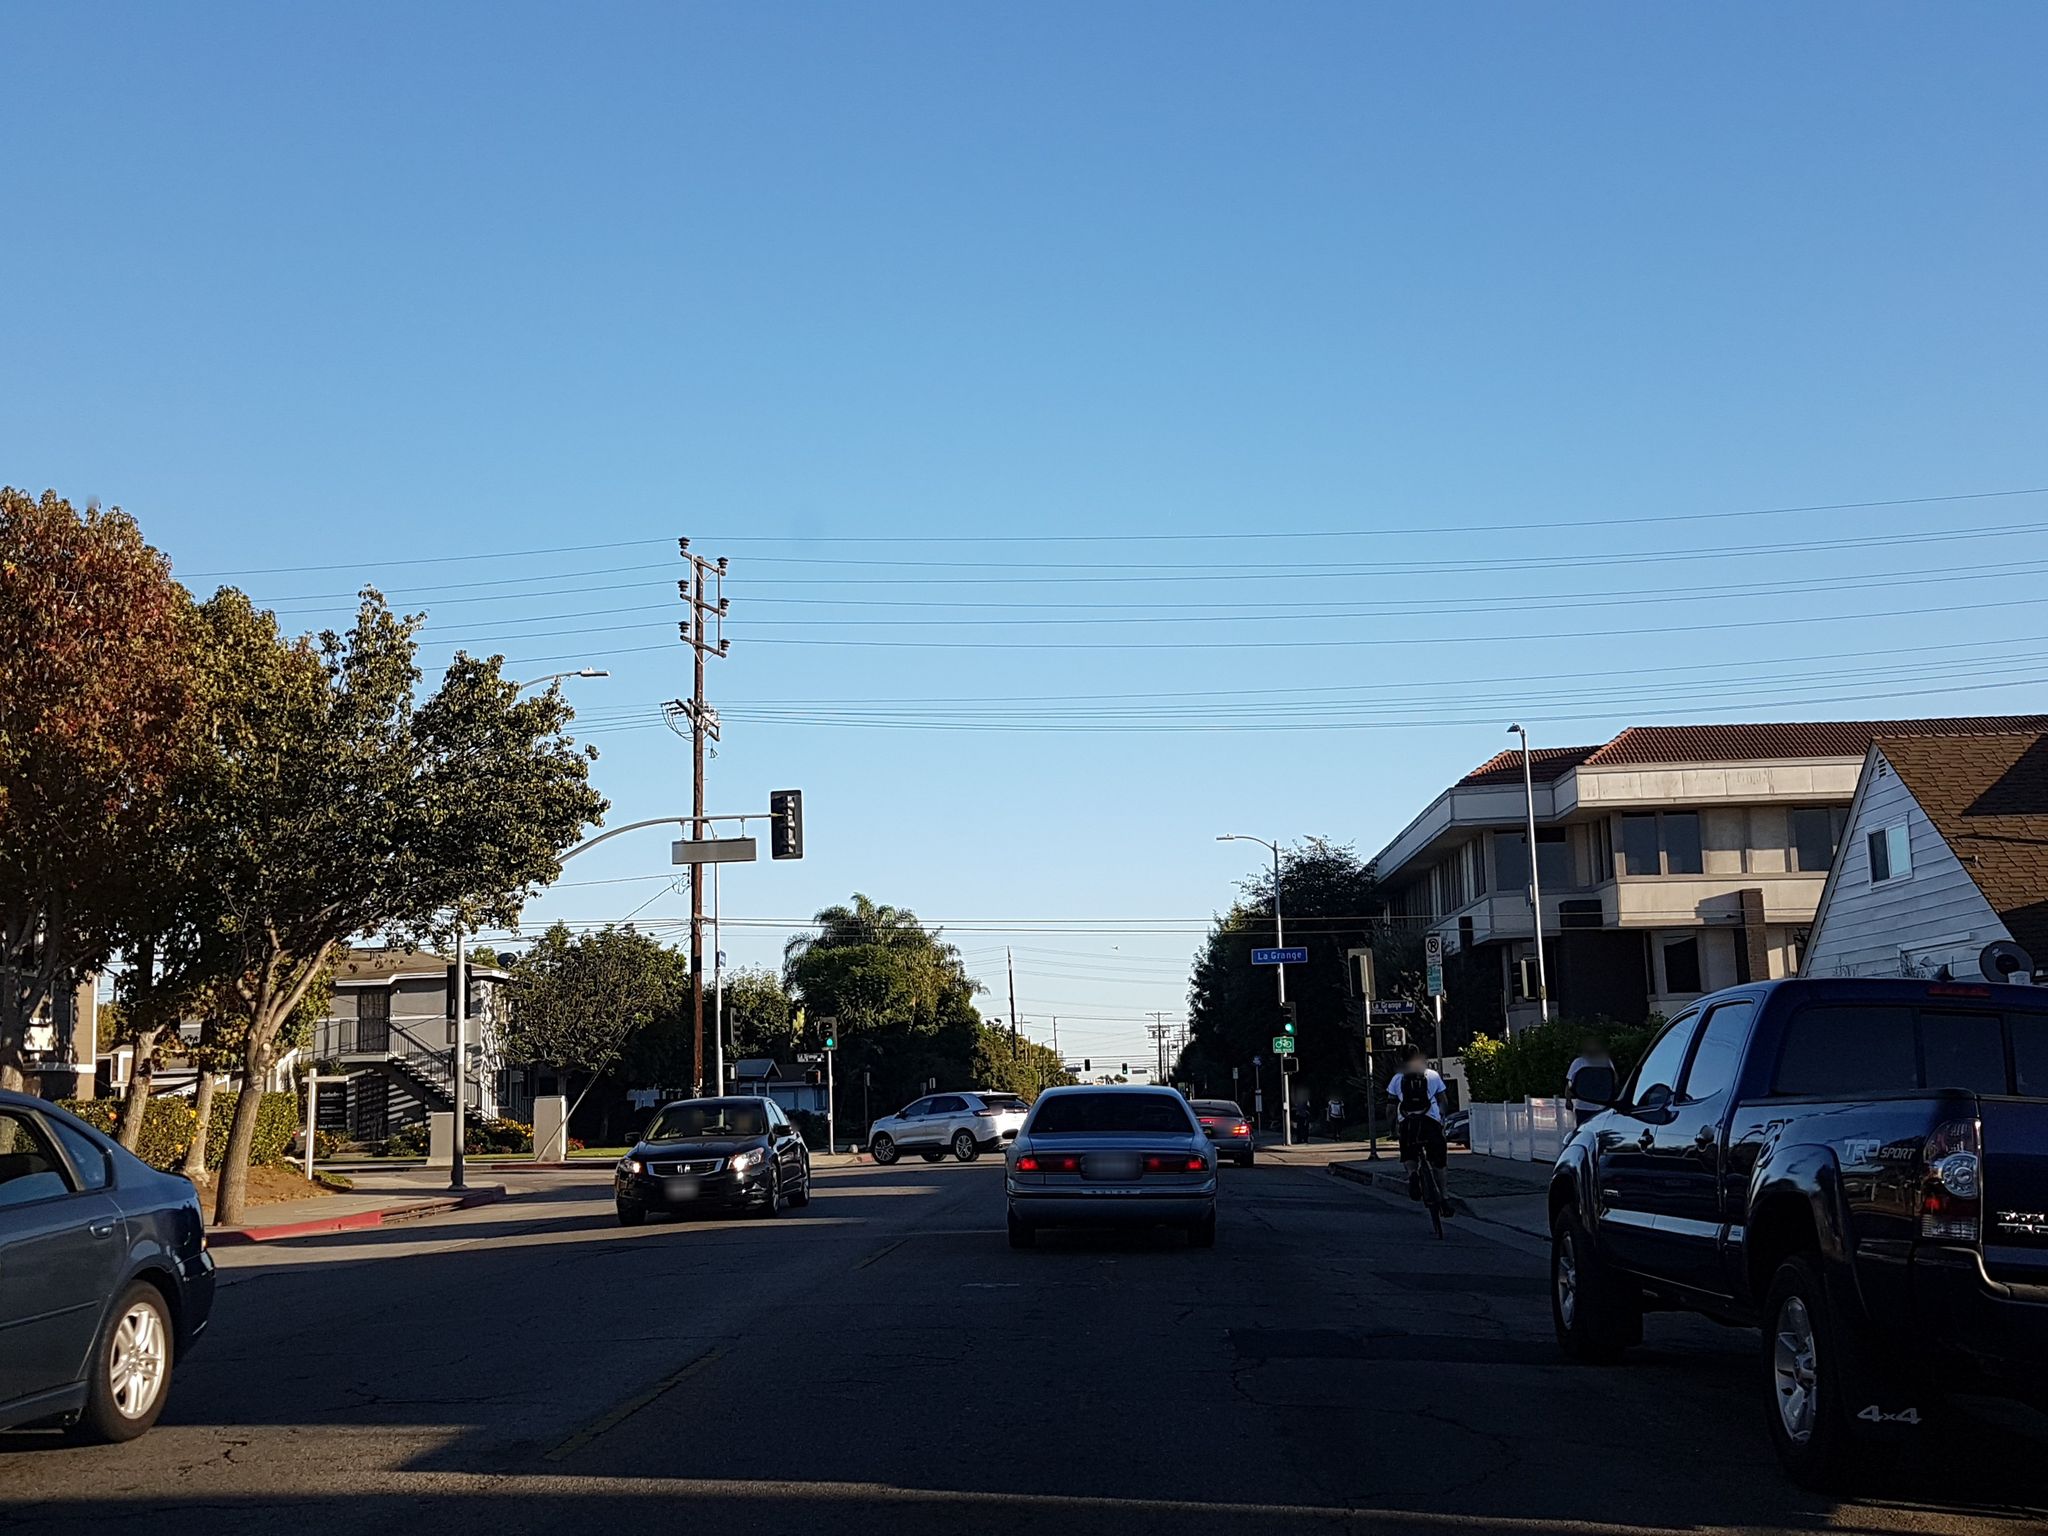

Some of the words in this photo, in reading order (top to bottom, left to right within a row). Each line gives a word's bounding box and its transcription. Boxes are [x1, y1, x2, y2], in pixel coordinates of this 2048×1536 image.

[1257, 951, 1268, 961] La
[1270, 951, 1302, 961] Grange
[1381, 1001, 1402, 1011] Grange
[1844, 1138, 1880, 1163] TRD
[1879, 1146, 1916, 1160] SPORT
[1856, 1404, 1923, 1425] 4x4
